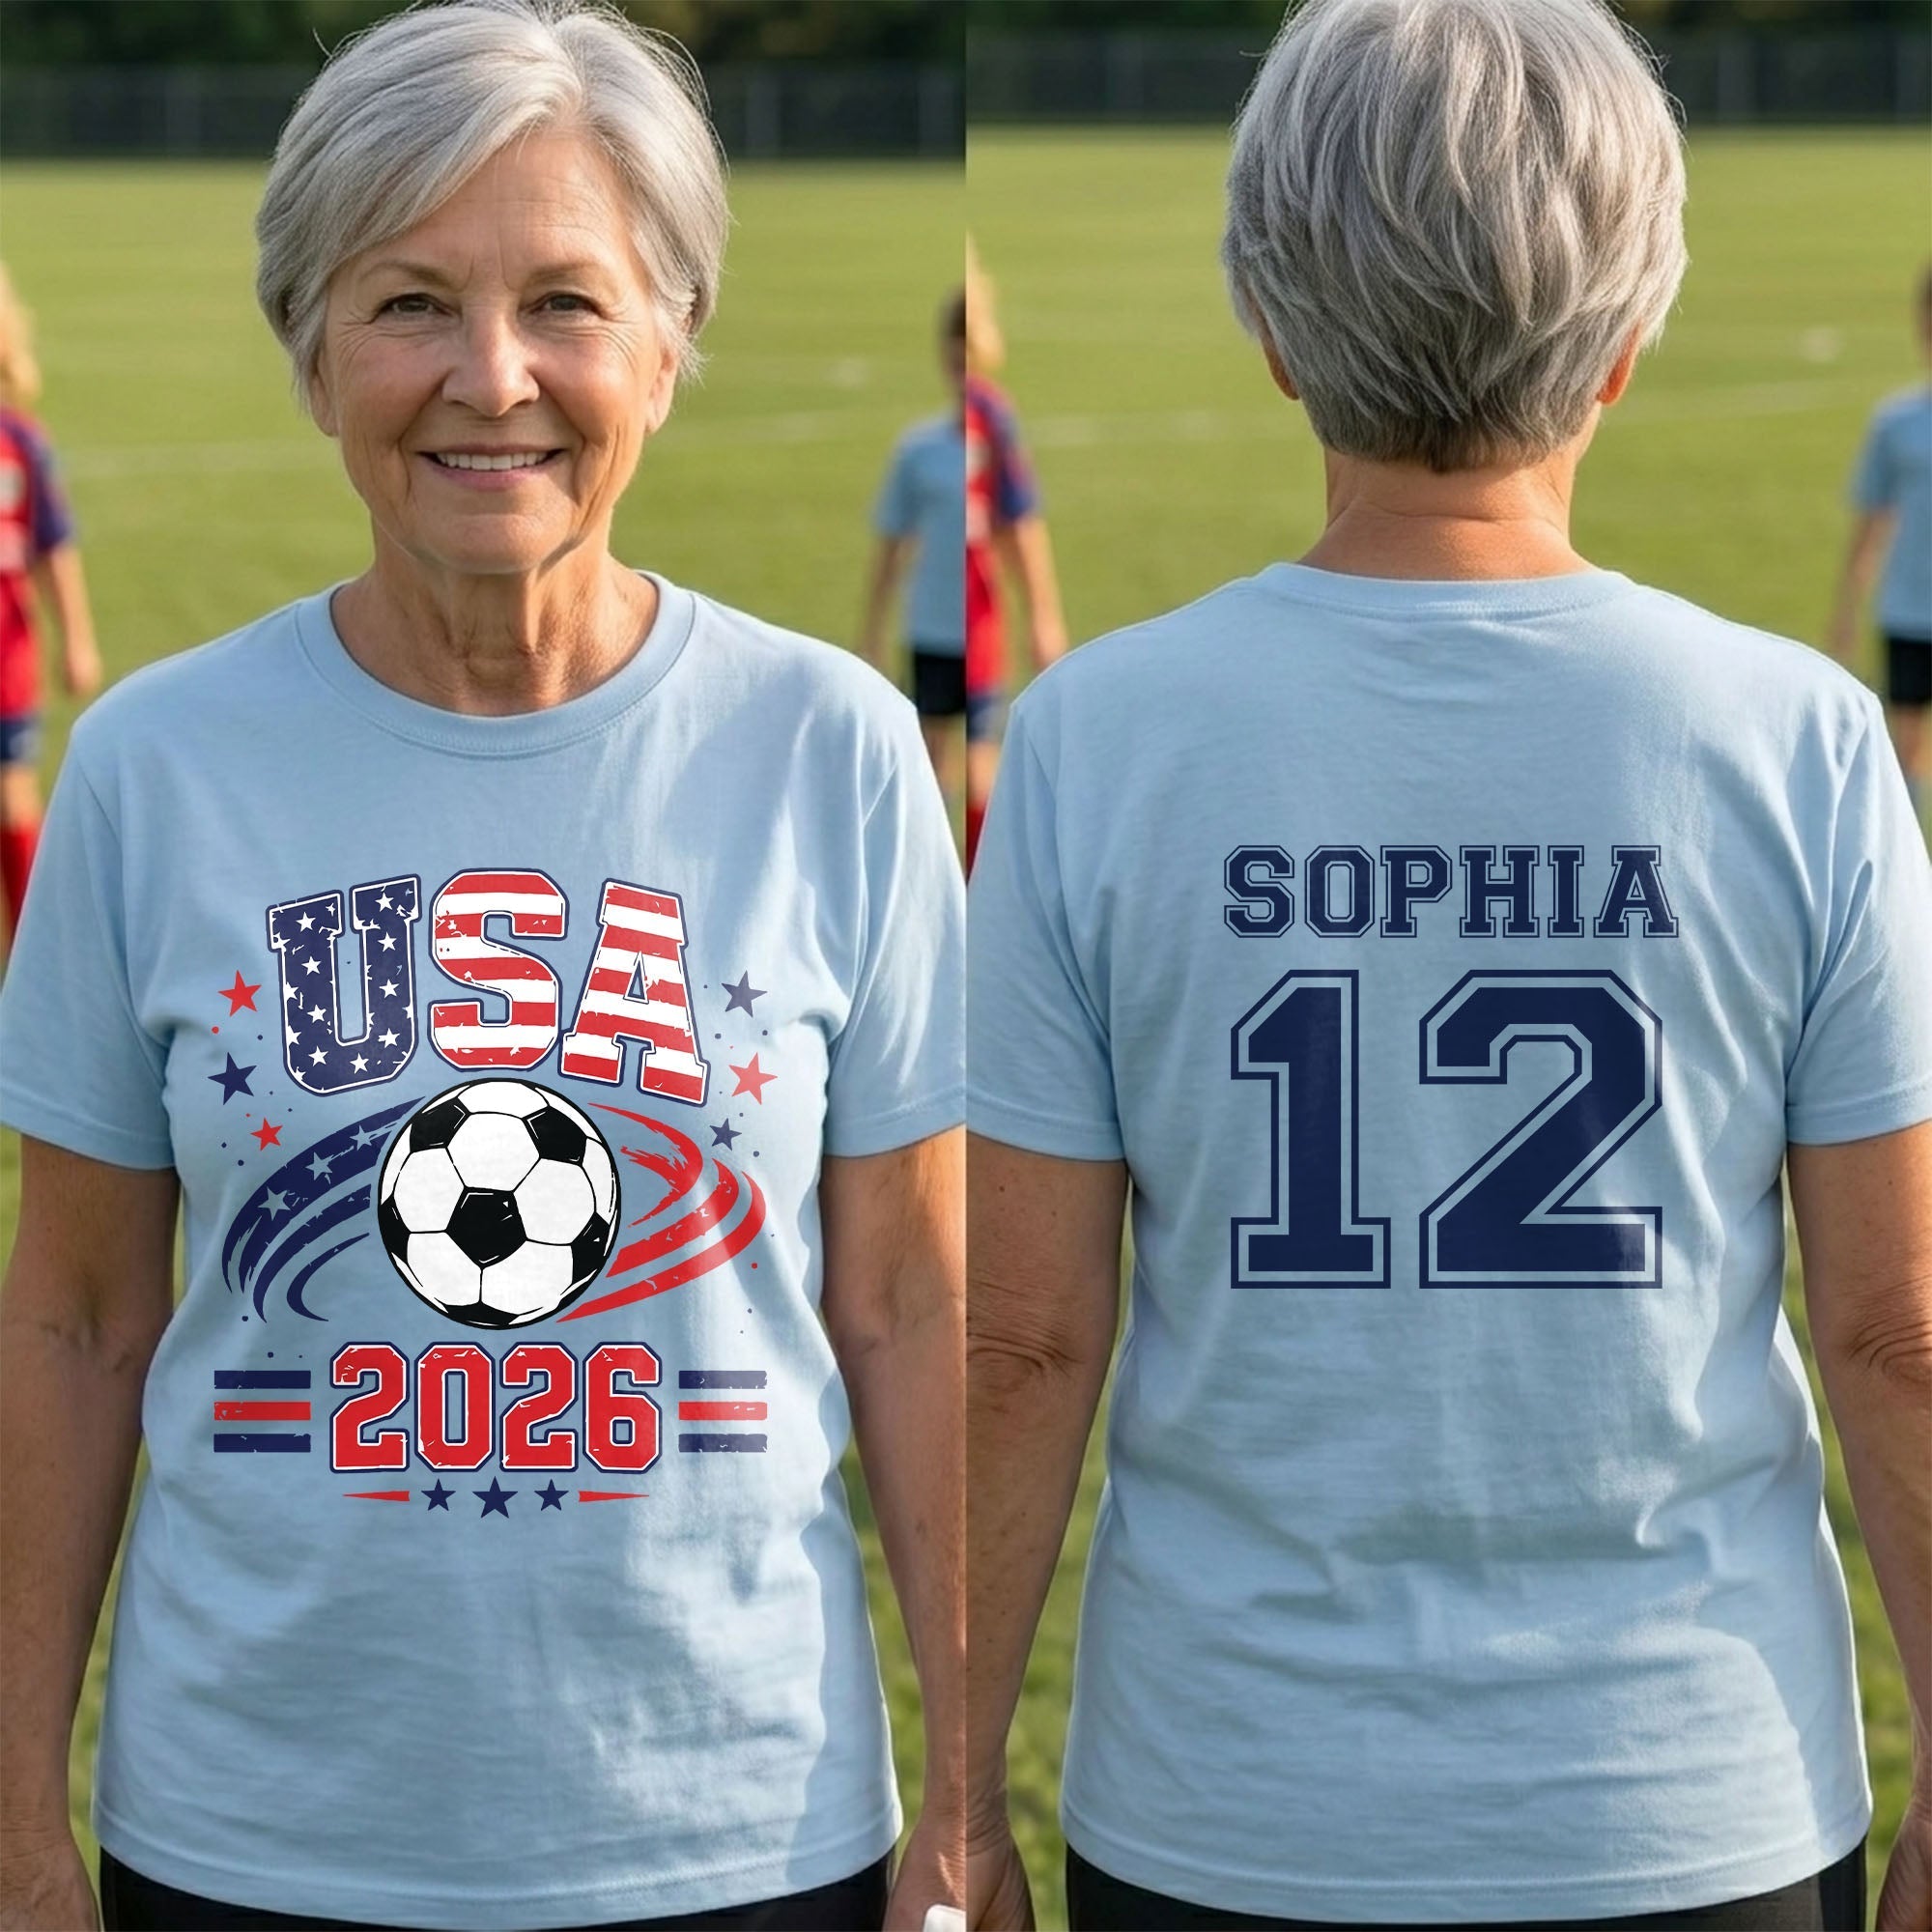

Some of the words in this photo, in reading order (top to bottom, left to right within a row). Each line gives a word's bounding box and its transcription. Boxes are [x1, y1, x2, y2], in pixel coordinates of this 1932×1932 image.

[1224, 844, 1679, 939] SOPHIA
[266, 867, 710, 1106] USA
[1231, 969, 1662, 1290] 12
[330, 1342, 664, 1474] 2026
